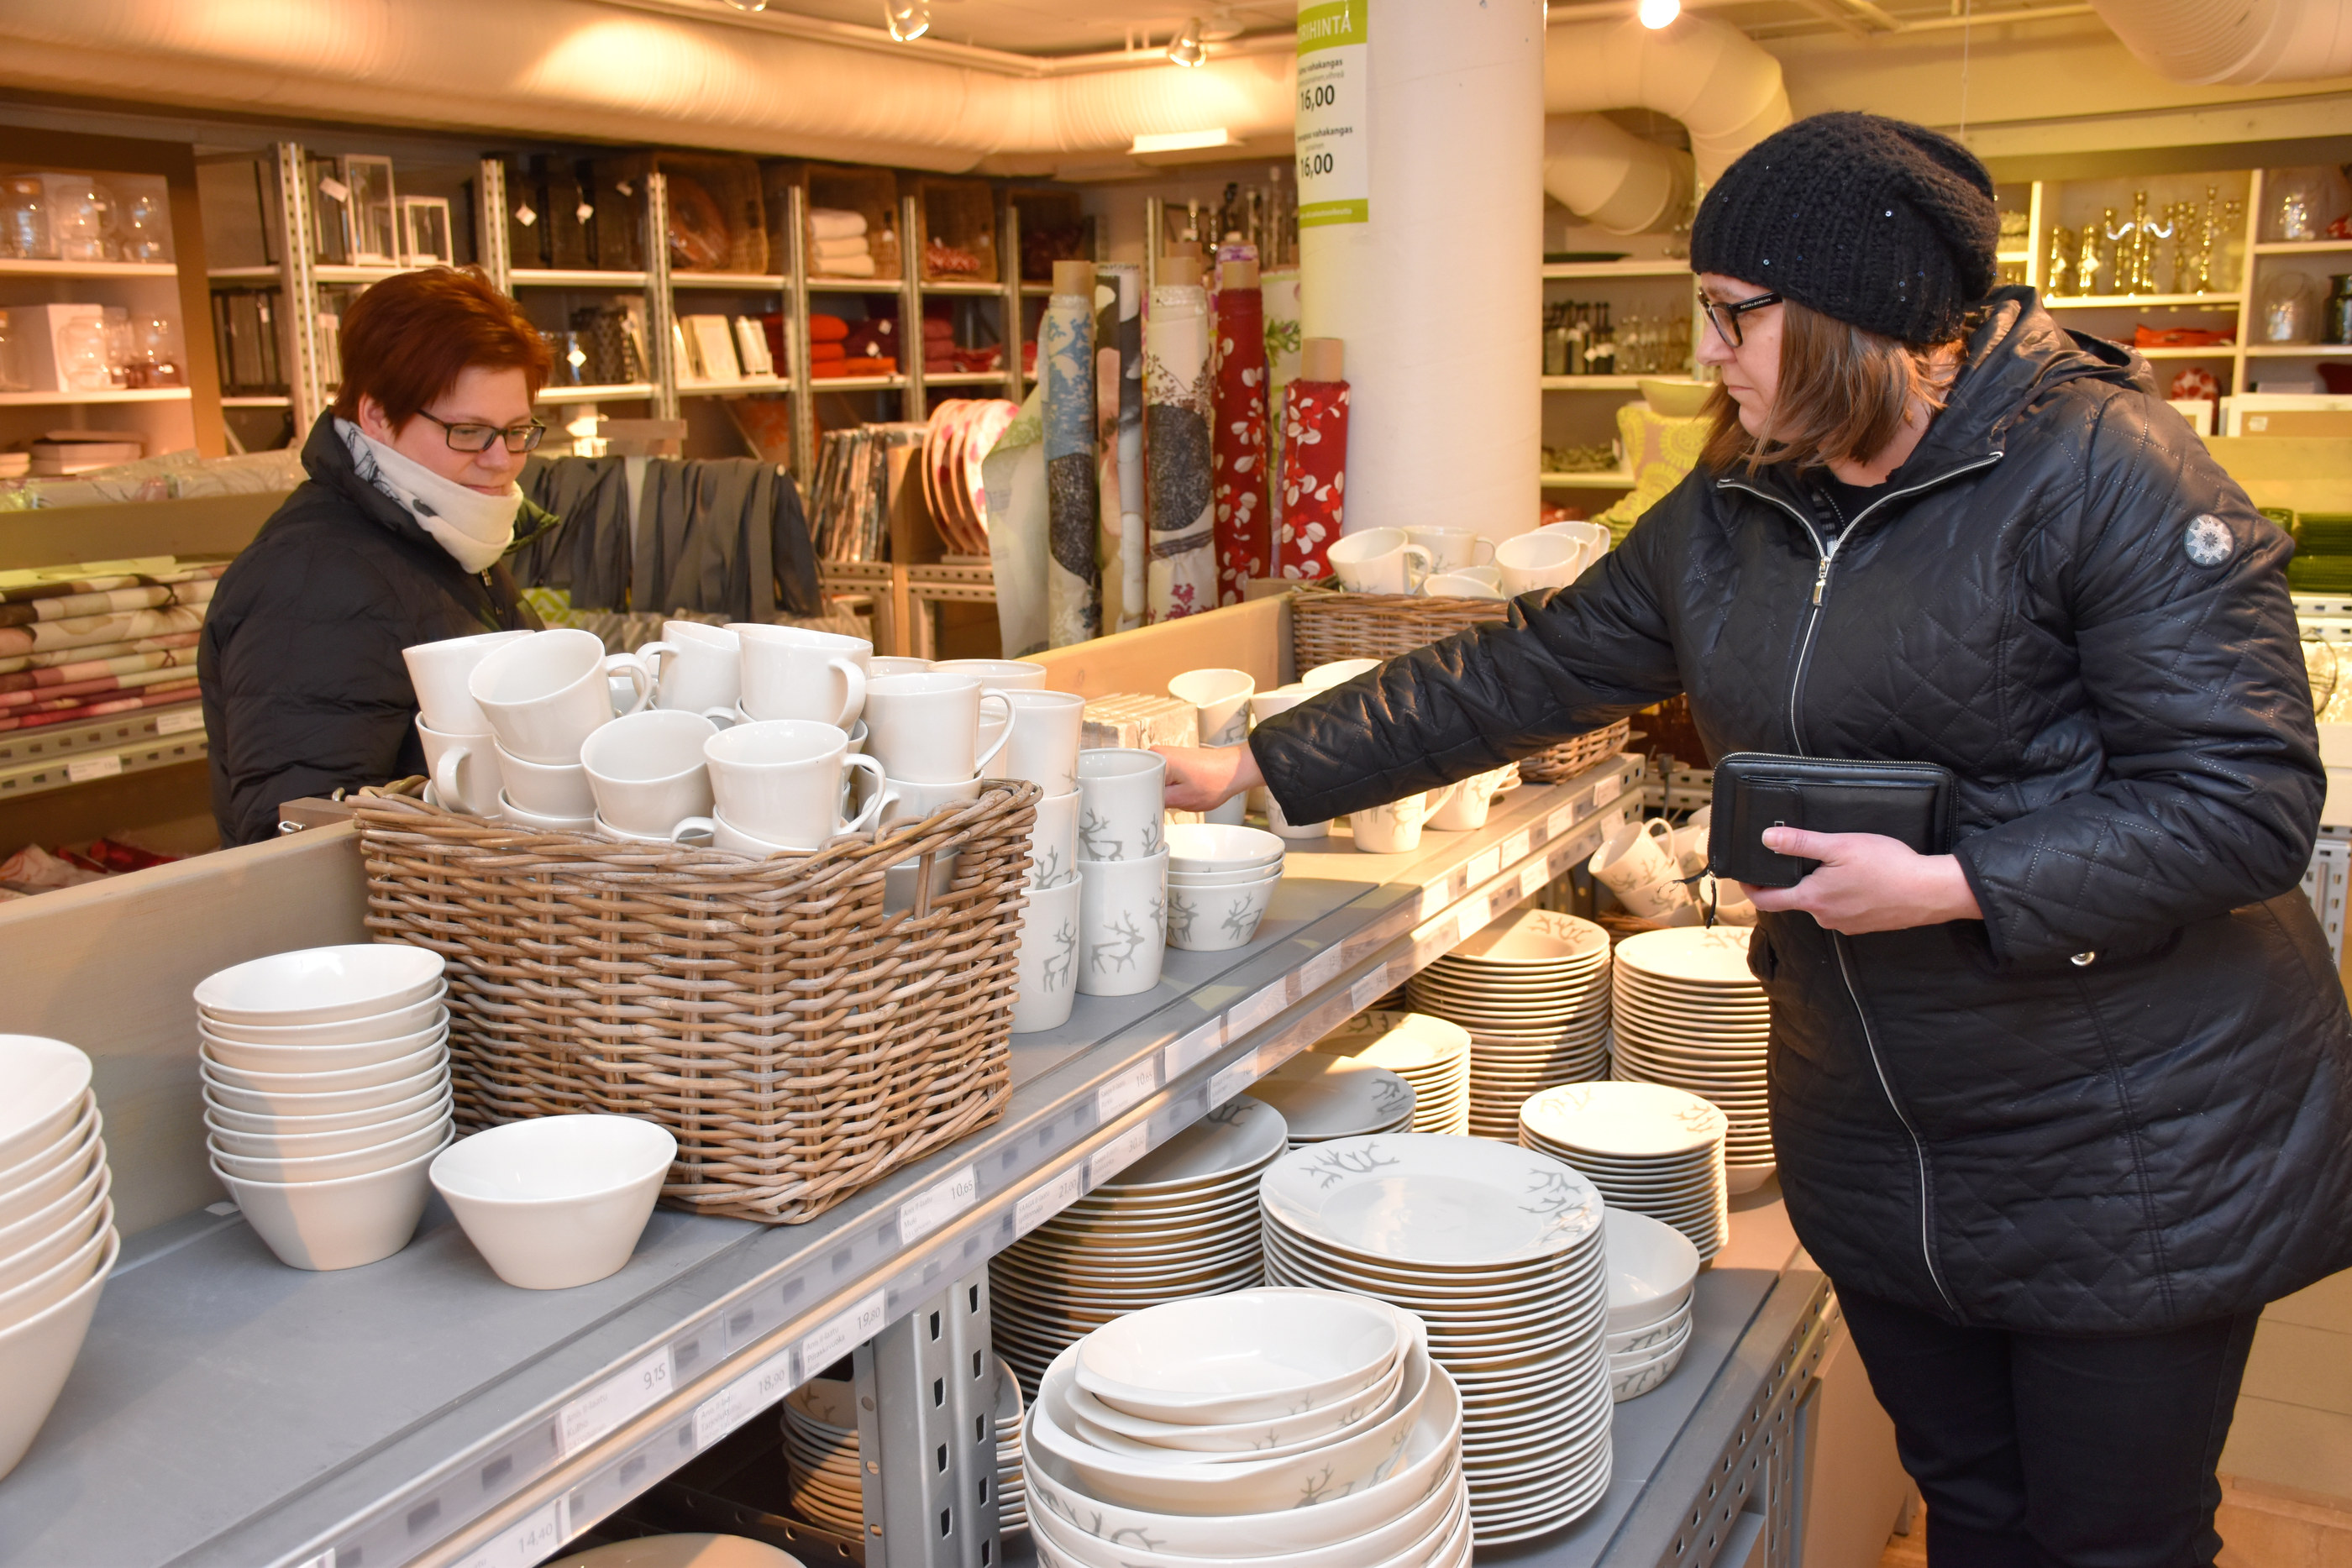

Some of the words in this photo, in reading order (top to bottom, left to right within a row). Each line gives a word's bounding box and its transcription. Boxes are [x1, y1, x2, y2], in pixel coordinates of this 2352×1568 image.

[1300, 84, 1335, 112] 16,00
[1312, 126, 1352, 137] vahakangas
[1300, 153, 1333, 179] 16,00
[951, 1180, 974, 1200] 10,65
[857, 1306, 881, 1330] 19,80
[643, 1362, 666, 1390] 9,15
[759, 1369, 785, 1396] 18,90
[519, 1523, 553, 1555] 14,40
